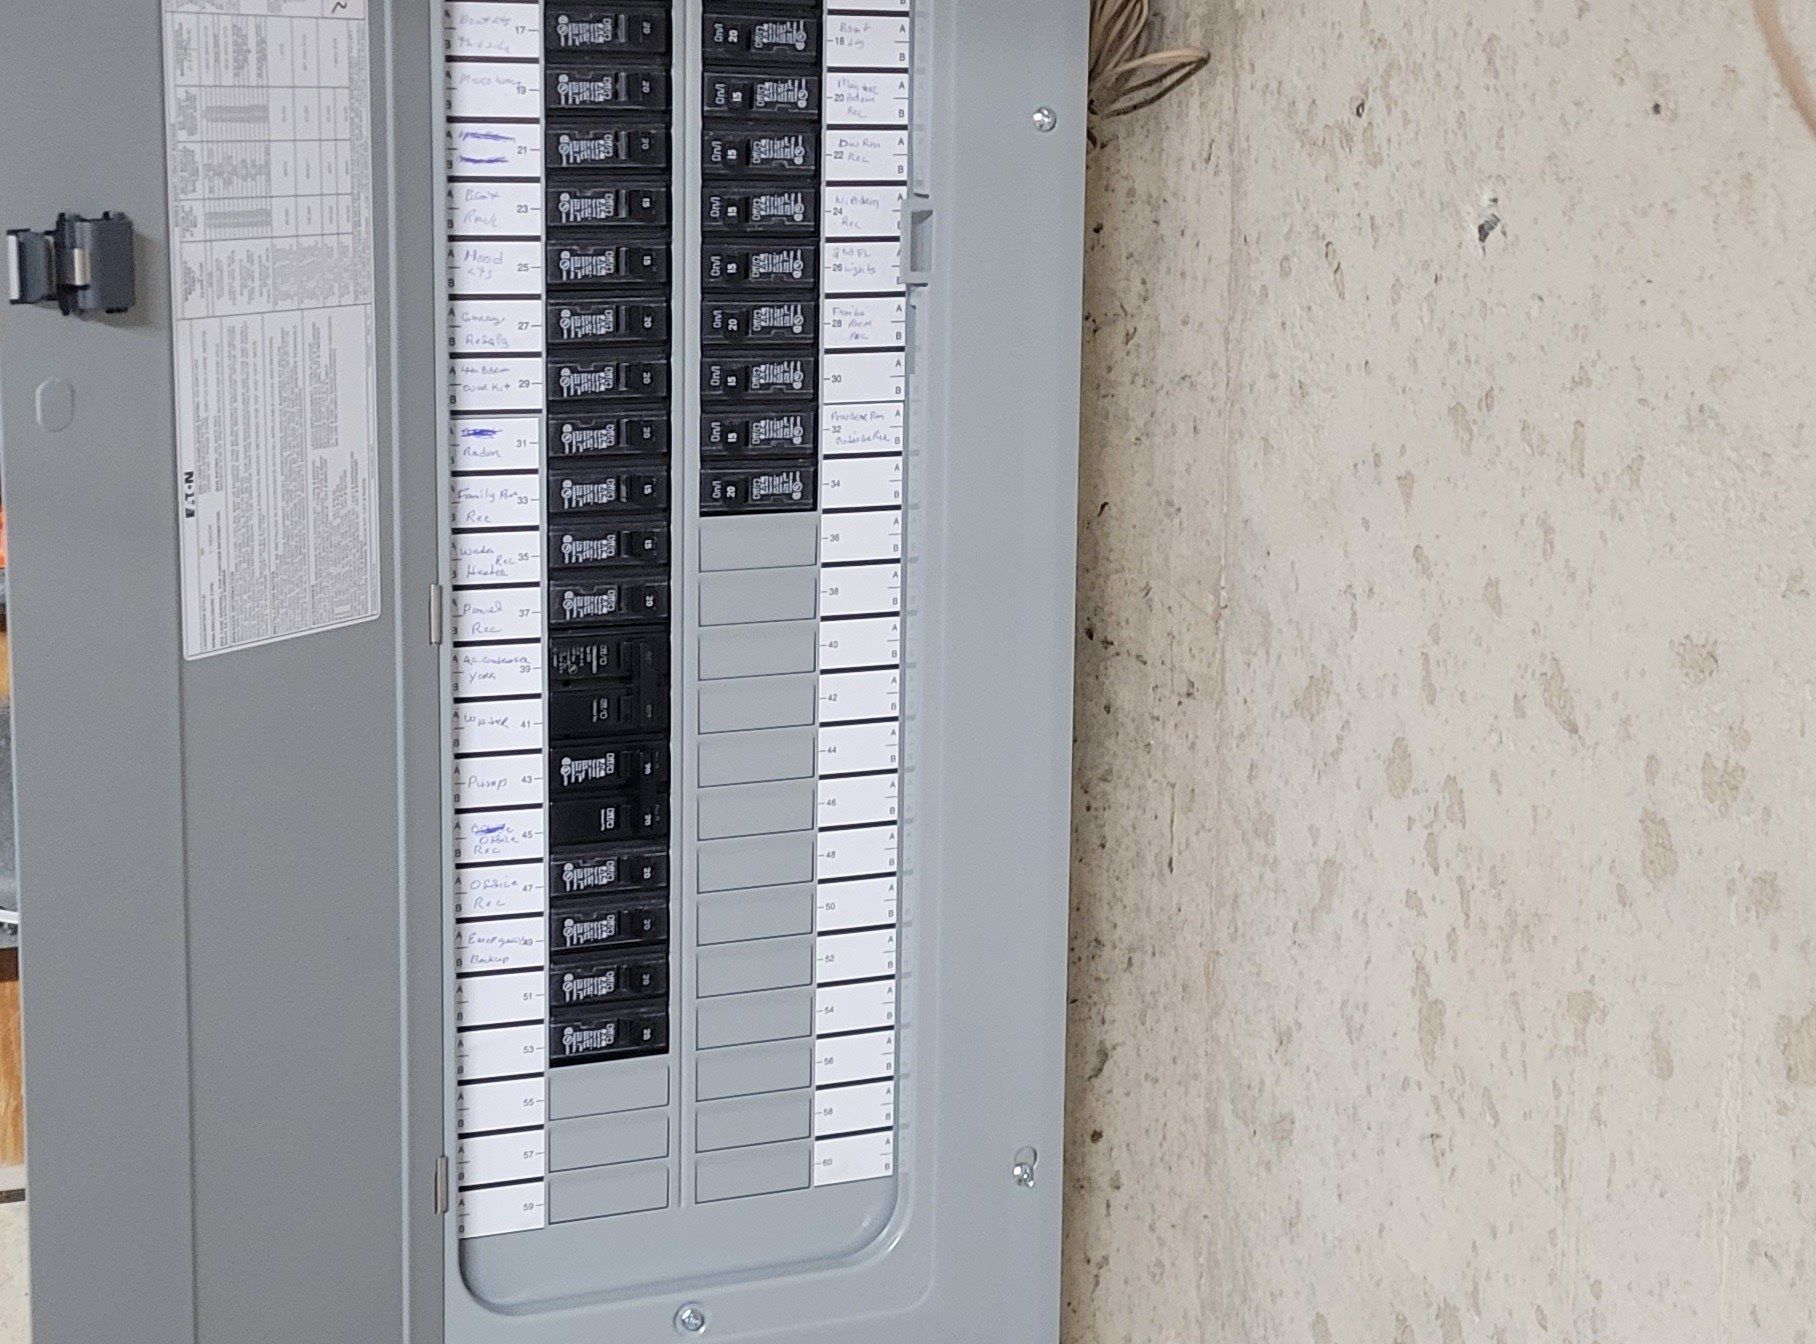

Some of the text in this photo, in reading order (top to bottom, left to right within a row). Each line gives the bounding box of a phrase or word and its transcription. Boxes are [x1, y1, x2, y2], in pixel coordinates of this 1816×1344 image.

[515, 25, 526, 35] 17
[899, 24, 906, 33] A
[728, 29, 738, 43] 20
[835, 36, 845, 46] 18
[833, 93, 845, 103] 20
[897, 137, 904, 146] A
[516, 145, 527, 155] 21
[833, 151, 844, 160] 22
[516, 204, 528, 214] 23
[832, 207, 843, 216] 24
[517, 263, 529, 272] 25
[726, 263, 737, 273] 15
[895, 304, 902, 312] A
[517, 321, 529, 331] 27
[728, 318, 738, 331] 20
[831, 374, 842, 383] 30
[518, 379, 530, 388] 29
[831, 425, 841, 434] 32
[515, 439, 527, 448] 31
[830, 480, 841, 488] 34
[726, 486, 736, 498] 20
[516, 496, 528, 505] 33
[893, 517, 899, 525] A
[518, 552, 529, 561] 35
[518, 608, 530, 618] 37
[828, 641, 838, 649] 40
[519, 665, 531, 674] 39
[827, 694, 838, 702] 42
[520, 720, 531, 728] 41
[827, 746, 837, 754] 44
[521, 775, 532, 784] 43
[826, 798, 837, 806] 46
[521, 830, 533, 839] 45
[454, 849, 462, 857] B
[826, 851, 836, 859] 48
[521, 884, 533, 892] 47
[825, 902, 836, 911] 50
[824, 954, 835, 963] 52
[456, 985, 463, 994] A
[522, 992, 533, 1001] 51
[824, 1006, 835, 1014] 54
[523, 1045, 534, 1054] 53
[824, 1057, 834, 1066] 56
[522, 1098, 535, 1107] 55
[823, 1108, 833, 1116] 58
[522, 1150, 535, 1159] 57
[822, 1158, 833, 1166] 60
